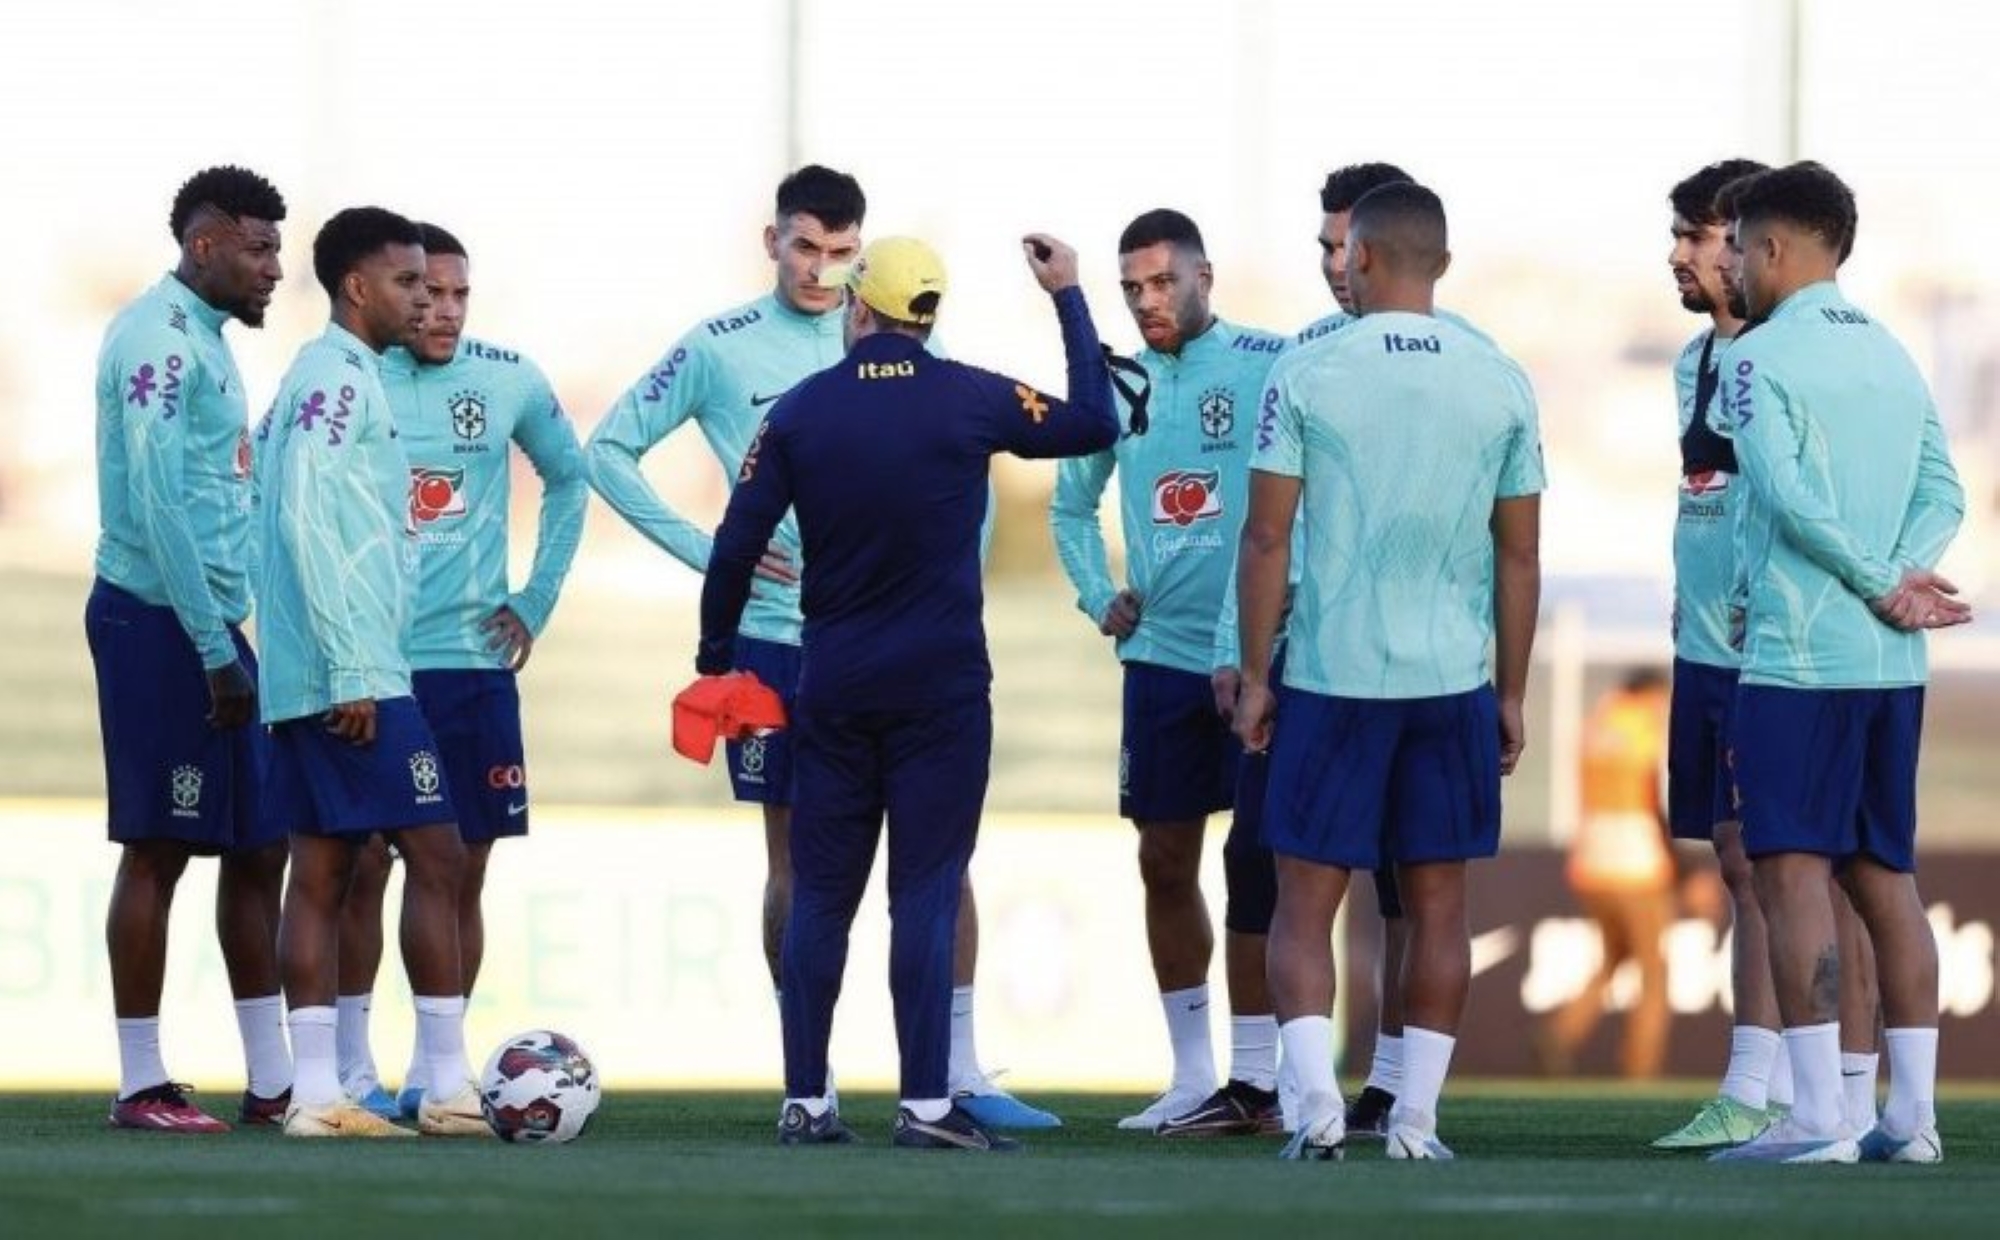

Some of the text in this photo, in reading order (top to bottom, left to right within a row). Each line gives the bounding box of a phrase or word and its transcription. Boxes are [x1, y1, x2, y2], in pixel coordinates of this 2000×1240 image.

[857, 360, 915, 380] Itaú
[1384, 333, 1441, 354] Itaú
[158, 355, 182, 421] vivo
[643, 347, 687, 402] vivo
[1730, 359, 1754, 428] vivo
[325, 384, 356, 446] vivo
[1257, 387, 1279, 452] vivo
[487, 765, 527, 789] GO
